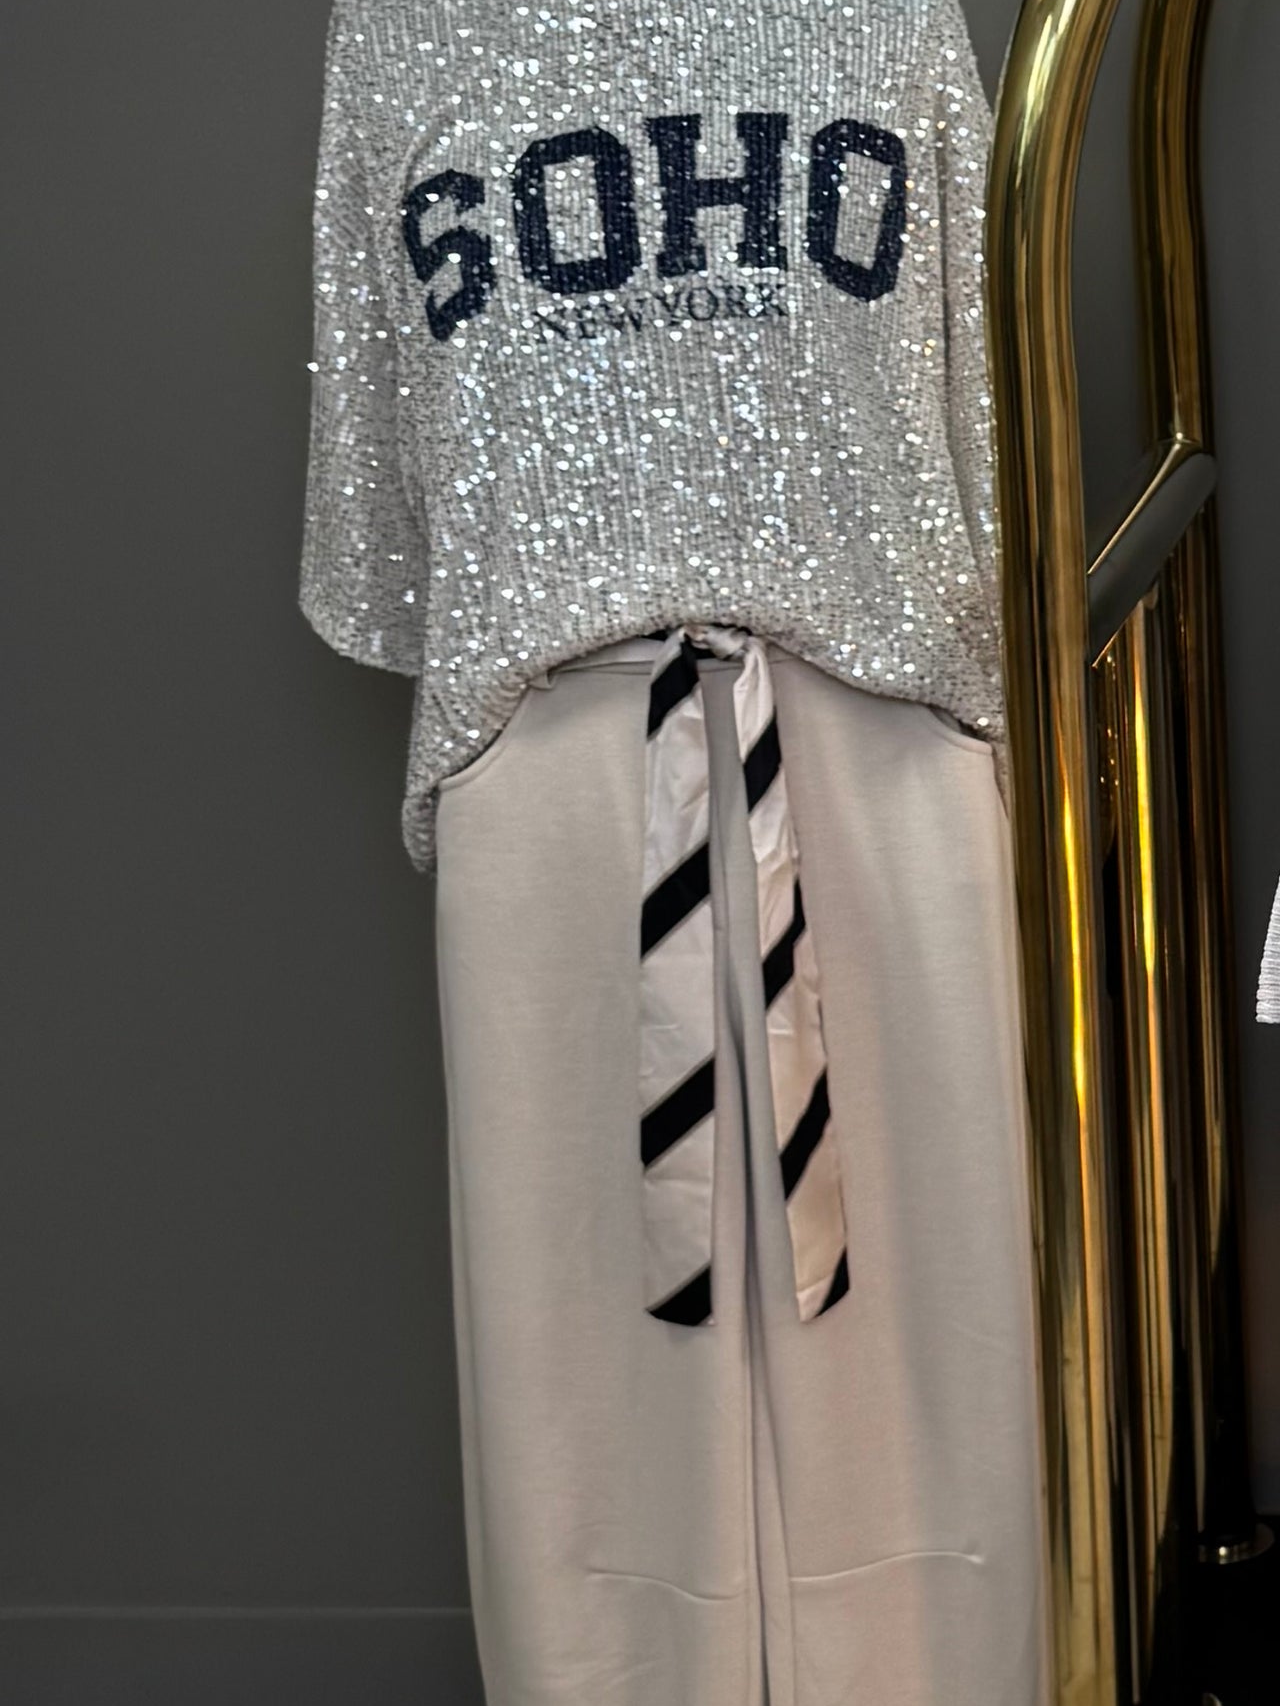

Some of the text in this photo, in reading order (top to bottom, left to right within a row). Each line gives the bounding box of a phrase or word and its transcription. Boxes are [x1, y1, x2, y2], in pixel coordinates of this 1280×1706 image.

[405, 110, 908, 343] SOHO
[532, 282, 791, 343] NEW YORK
